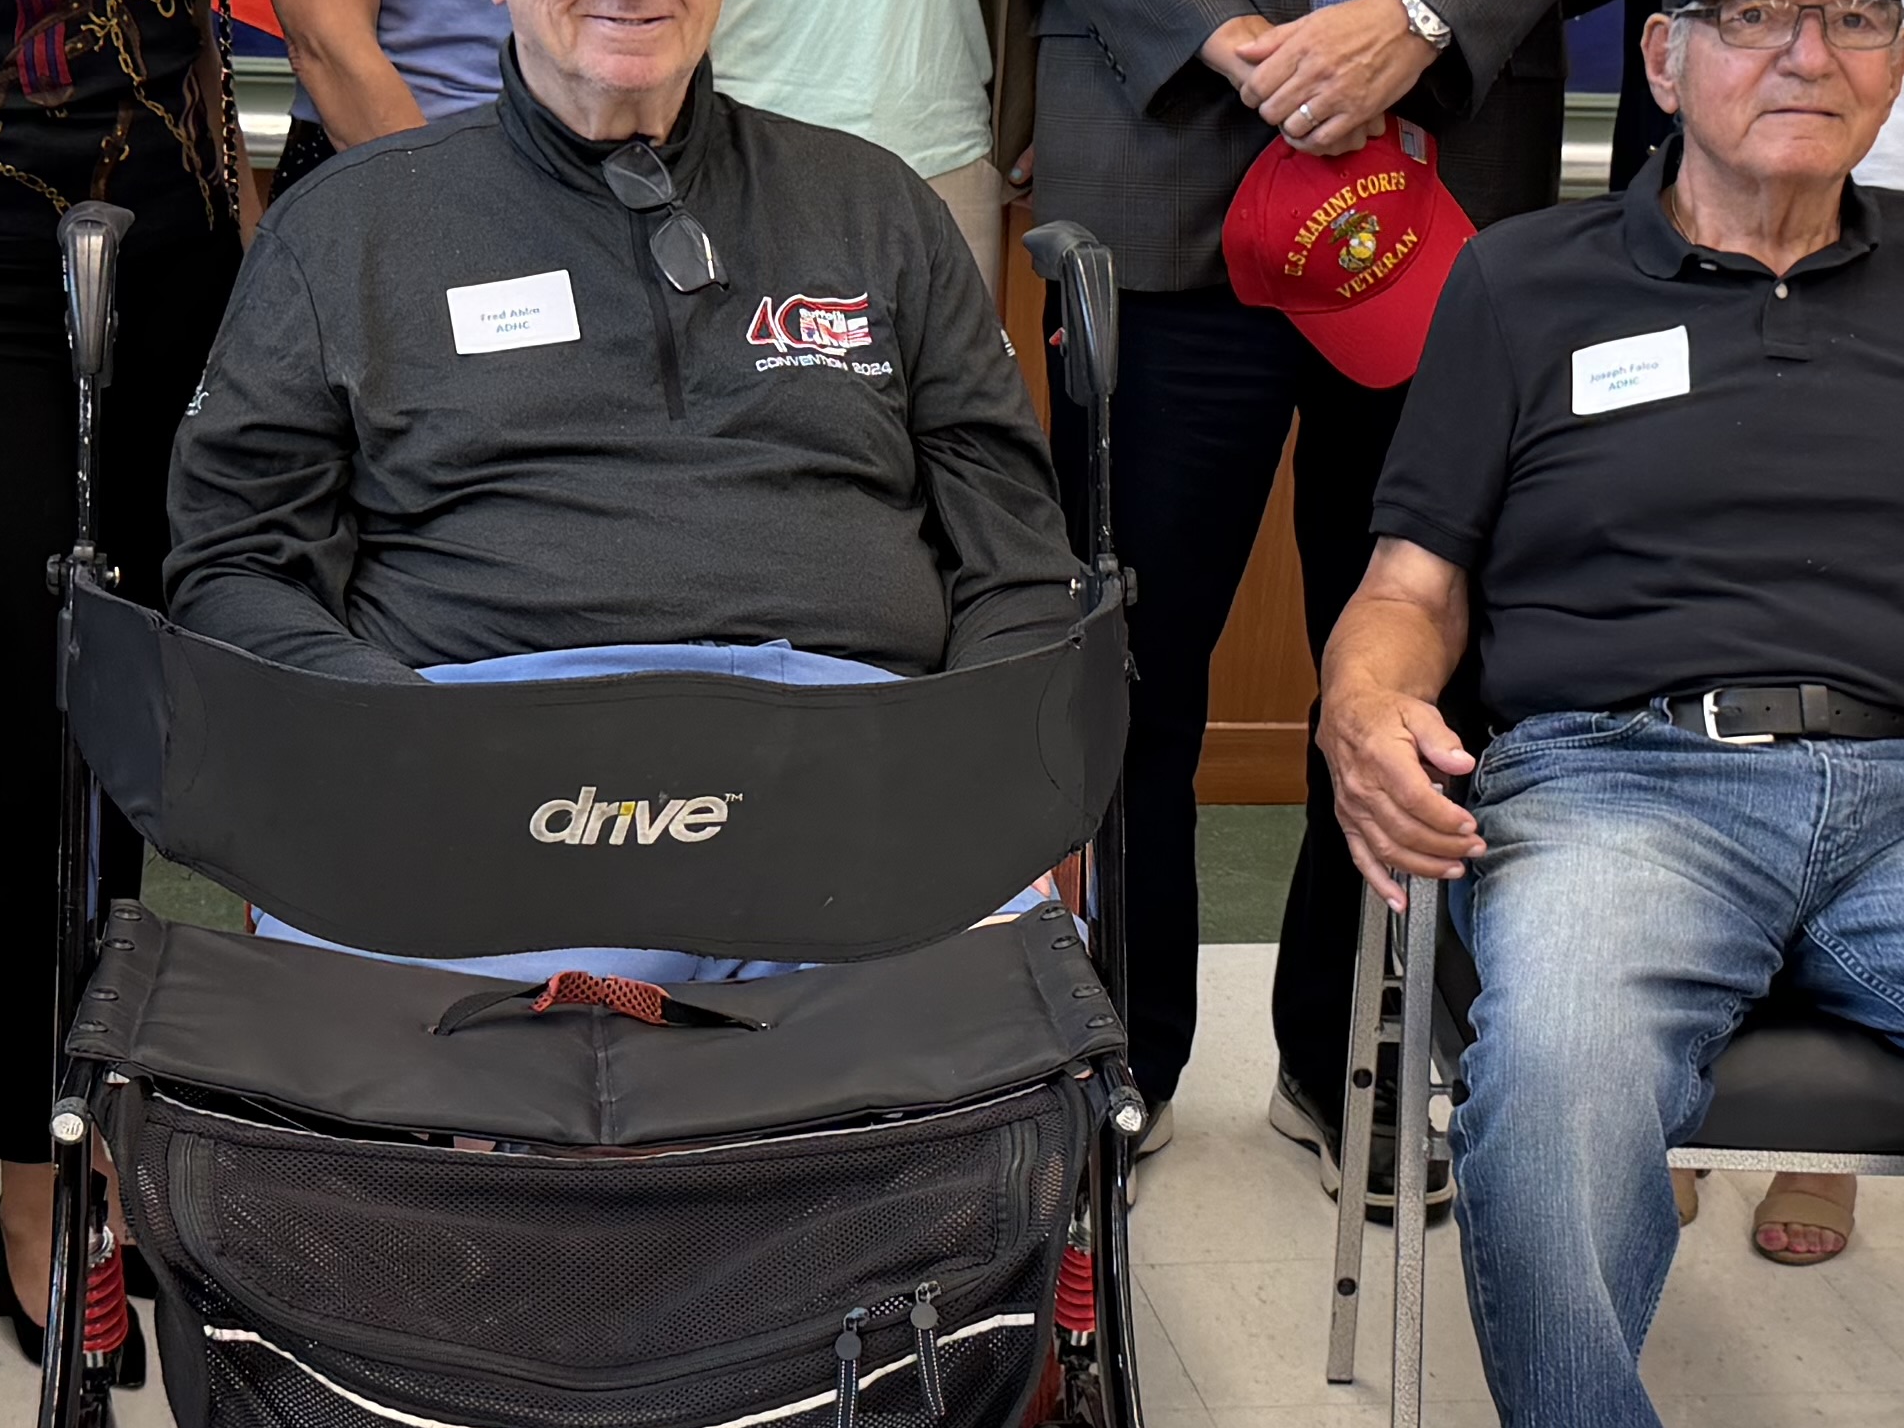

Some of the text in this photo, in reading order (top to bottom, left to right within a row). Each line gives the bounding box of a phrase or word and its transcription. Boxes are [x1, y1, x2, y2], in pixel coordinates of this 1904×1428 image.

[1294, 185, 1358, 250] MARINE
[1356, 170, 1407, 199] CORPS
[1335, 227, 1419, 299] VETERAN
[496, 321, 529, 334] ADHC
[852, 360, 894, 376] 2024
[529, 785, 729, 846] drive
